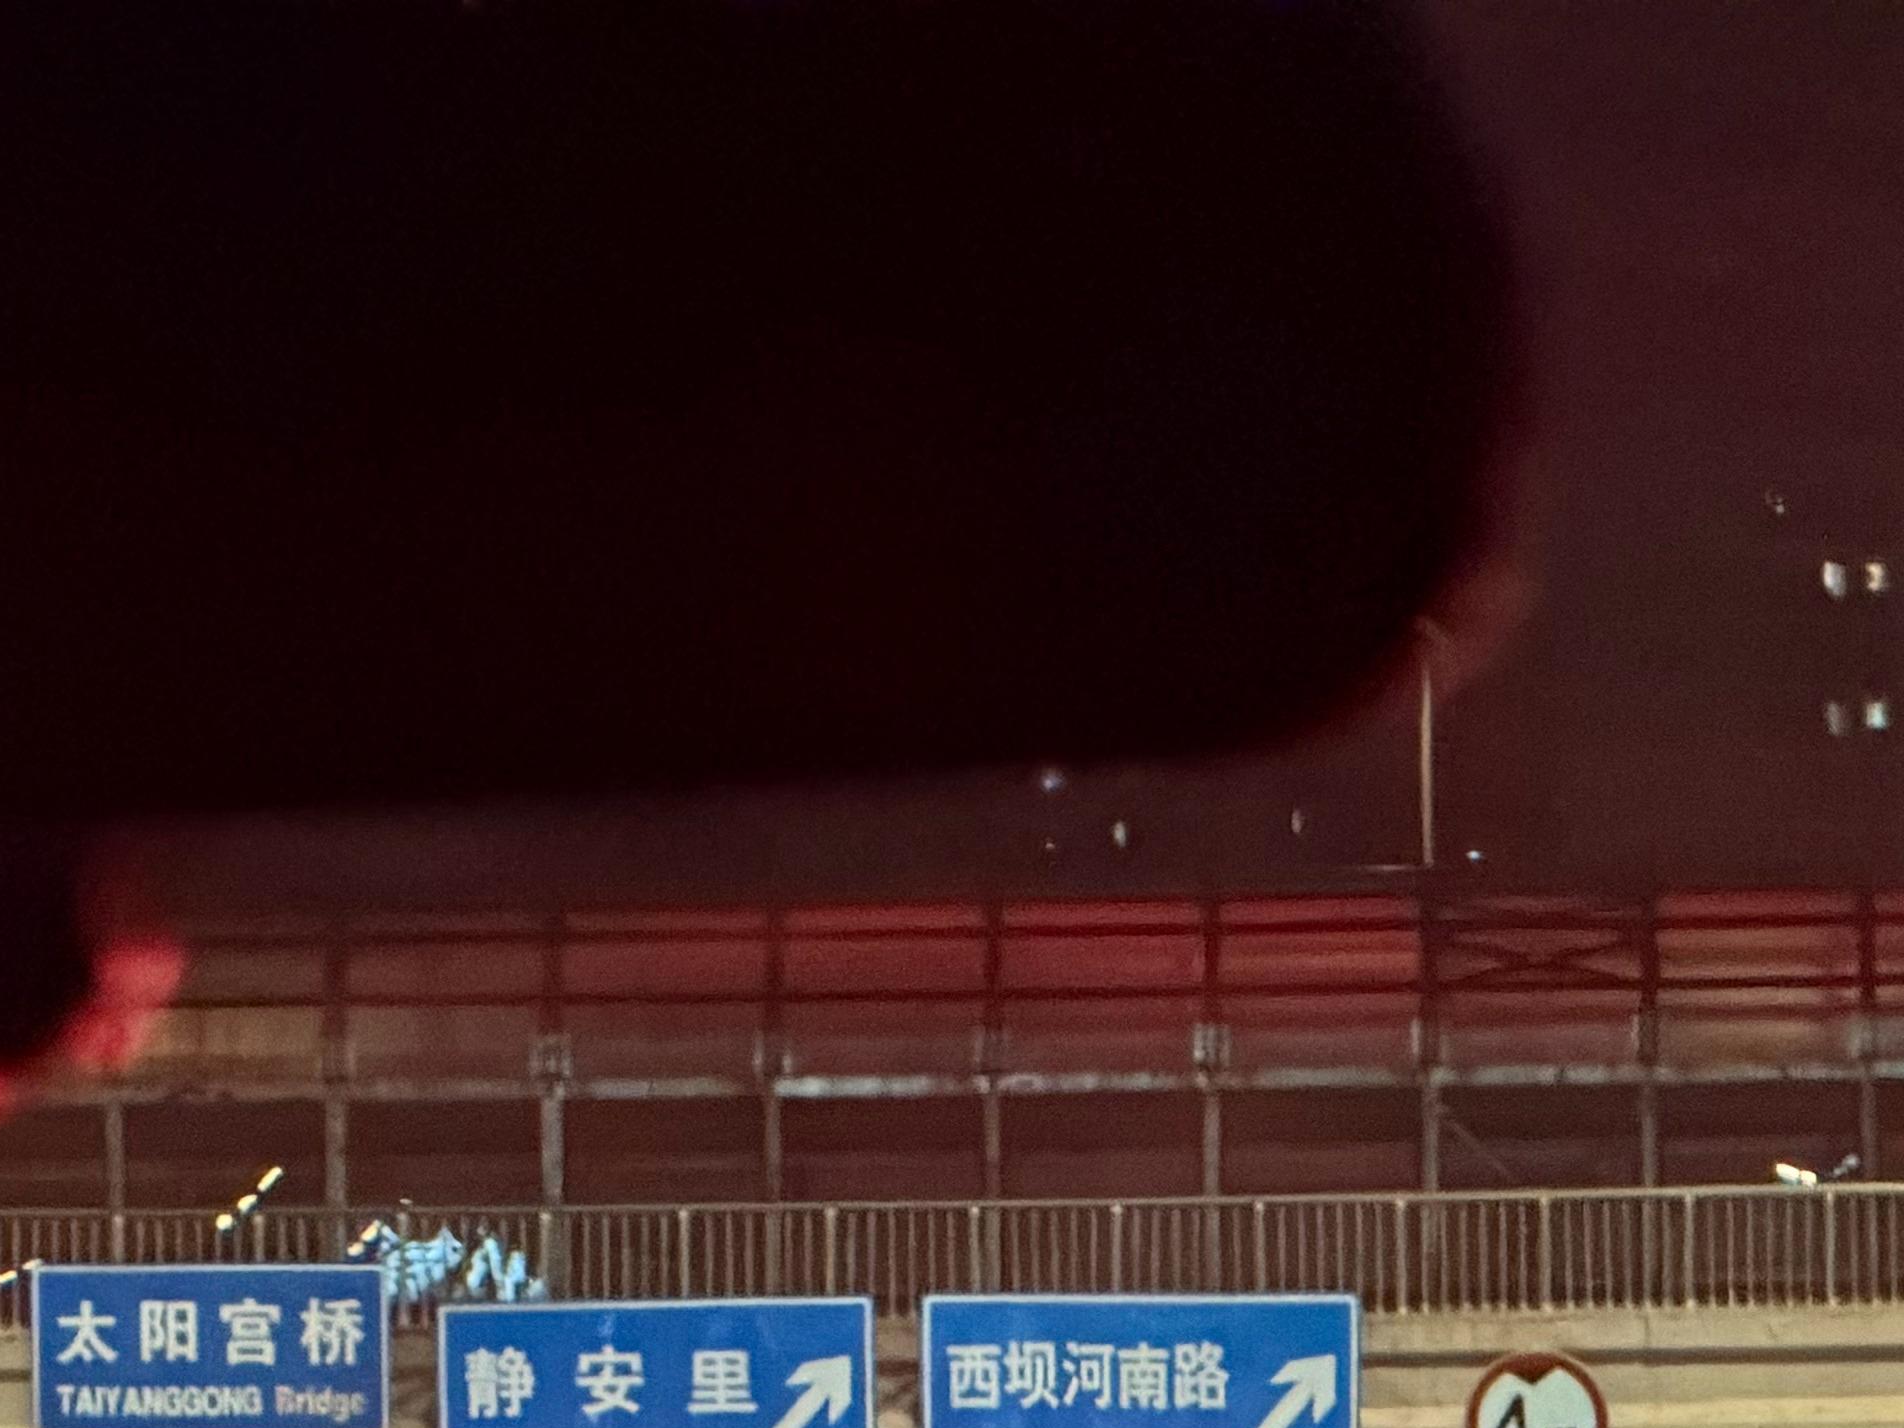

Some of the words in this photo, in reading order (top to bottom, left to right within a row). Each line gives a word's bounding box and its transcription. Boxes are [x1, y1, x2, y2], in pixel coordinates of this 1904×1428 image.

[56, 1297, 366, 1367] 太阳宫桥
[57, 1385, 263, 1417] TAIYANGGONG
[275, 1385, 367, 1422] Bridge
[465, 1345, 759, 1419] 静安里
[946, 1341, 1230, 1410] 西坝河南路
